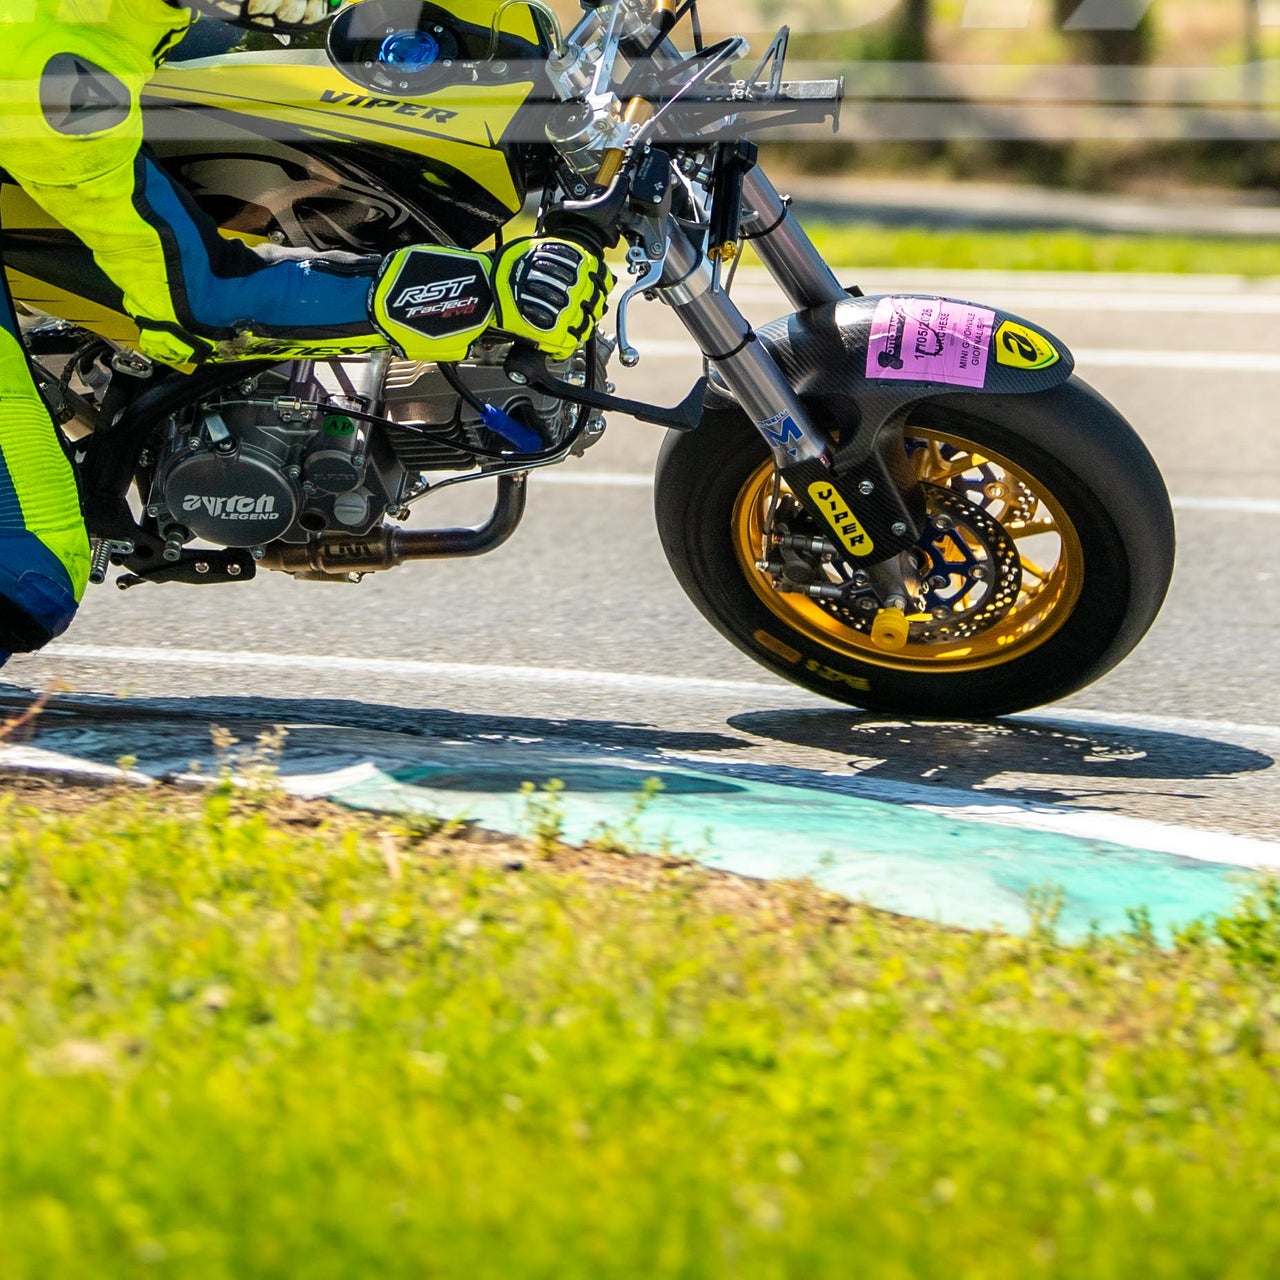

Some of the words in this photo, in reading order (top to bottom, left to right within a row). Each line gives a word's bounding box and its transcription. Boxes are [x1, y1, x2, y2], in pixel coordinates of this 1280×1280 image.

[319, 89, 459, 124] VIPER
[392, 275, 477, 307] RST
[959, 349, 968, 369] MINI
[182, 494, 274, 517] ayrton
[221, 512, 279, 520] LEGEND
[817, 489, 865, 547] VIPER
